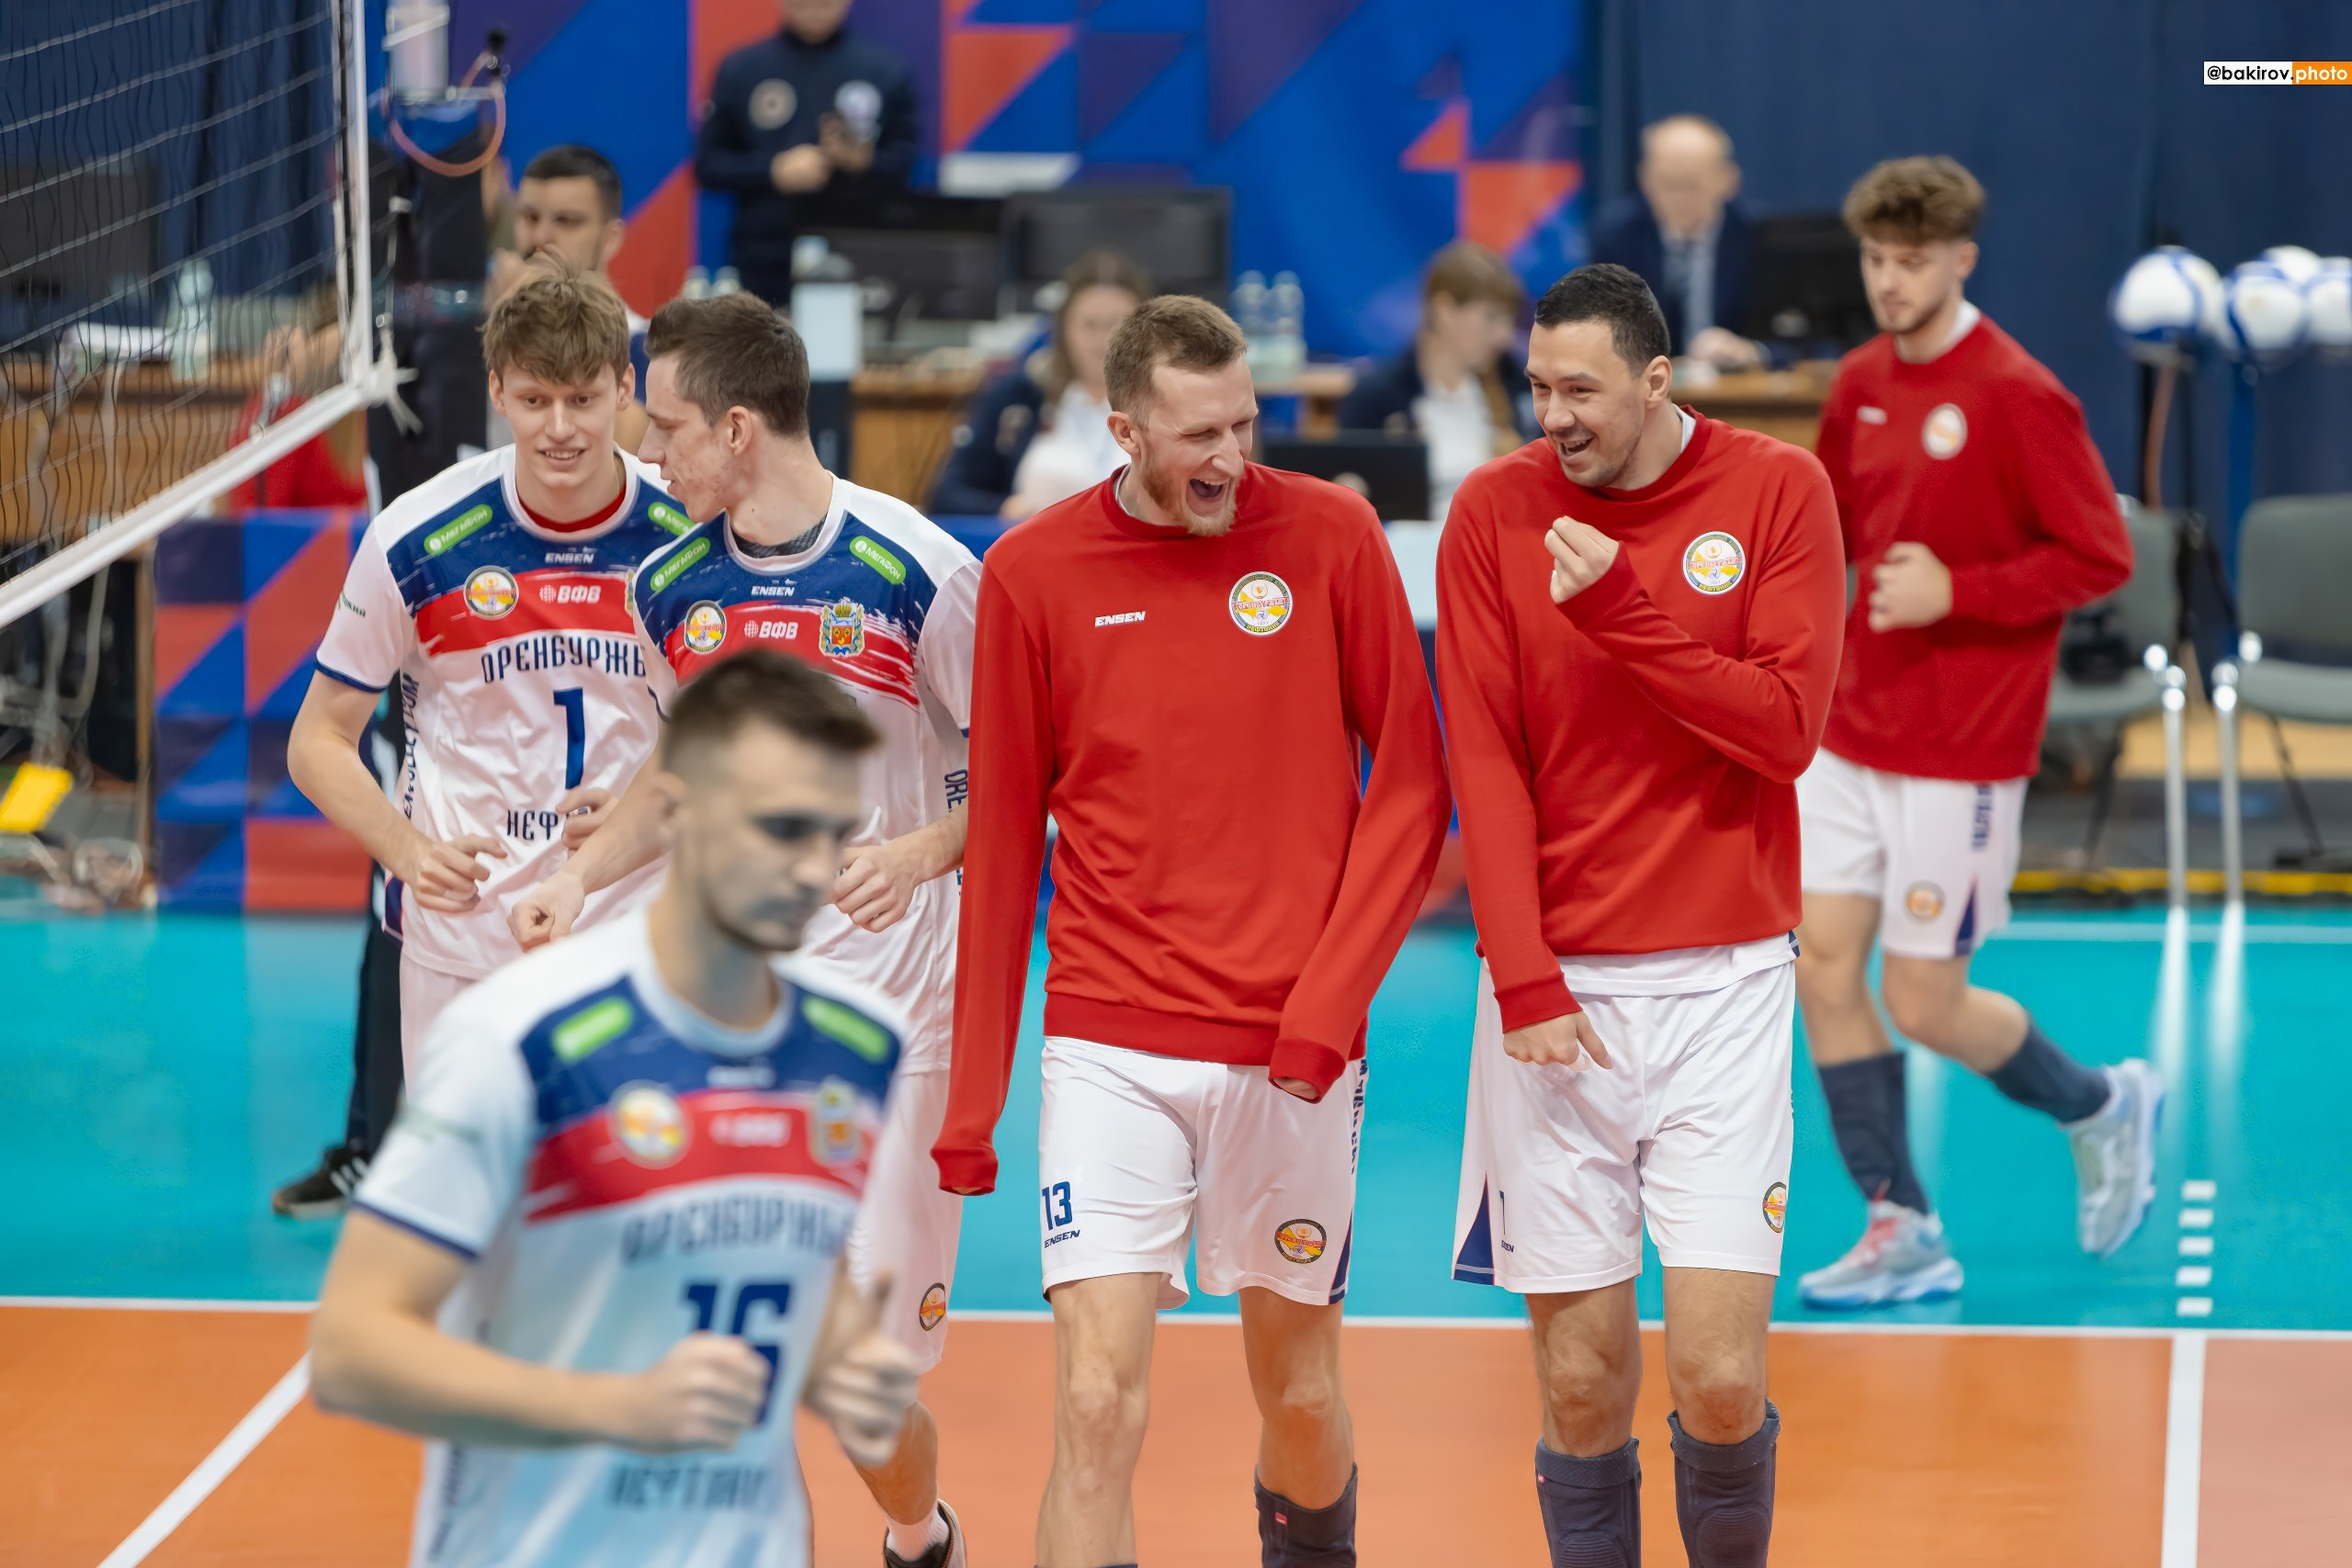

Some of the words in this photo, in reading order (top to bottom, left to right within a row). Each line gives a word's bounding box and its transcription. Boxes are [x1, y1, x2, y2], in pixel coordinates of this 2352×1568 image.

[545, 552, 594, 564] ENSEN
[557, 585, 602, 604] ВФВ
[751, 586, 796, 596] ENSEN
[1094, 611, 1147, 627] ENSEN
[759, 621, 798, 639] ВФВ
[1042, 1181, 1073, 1231] 13
[1044, 1229, 1081, 1249] ENSEN
